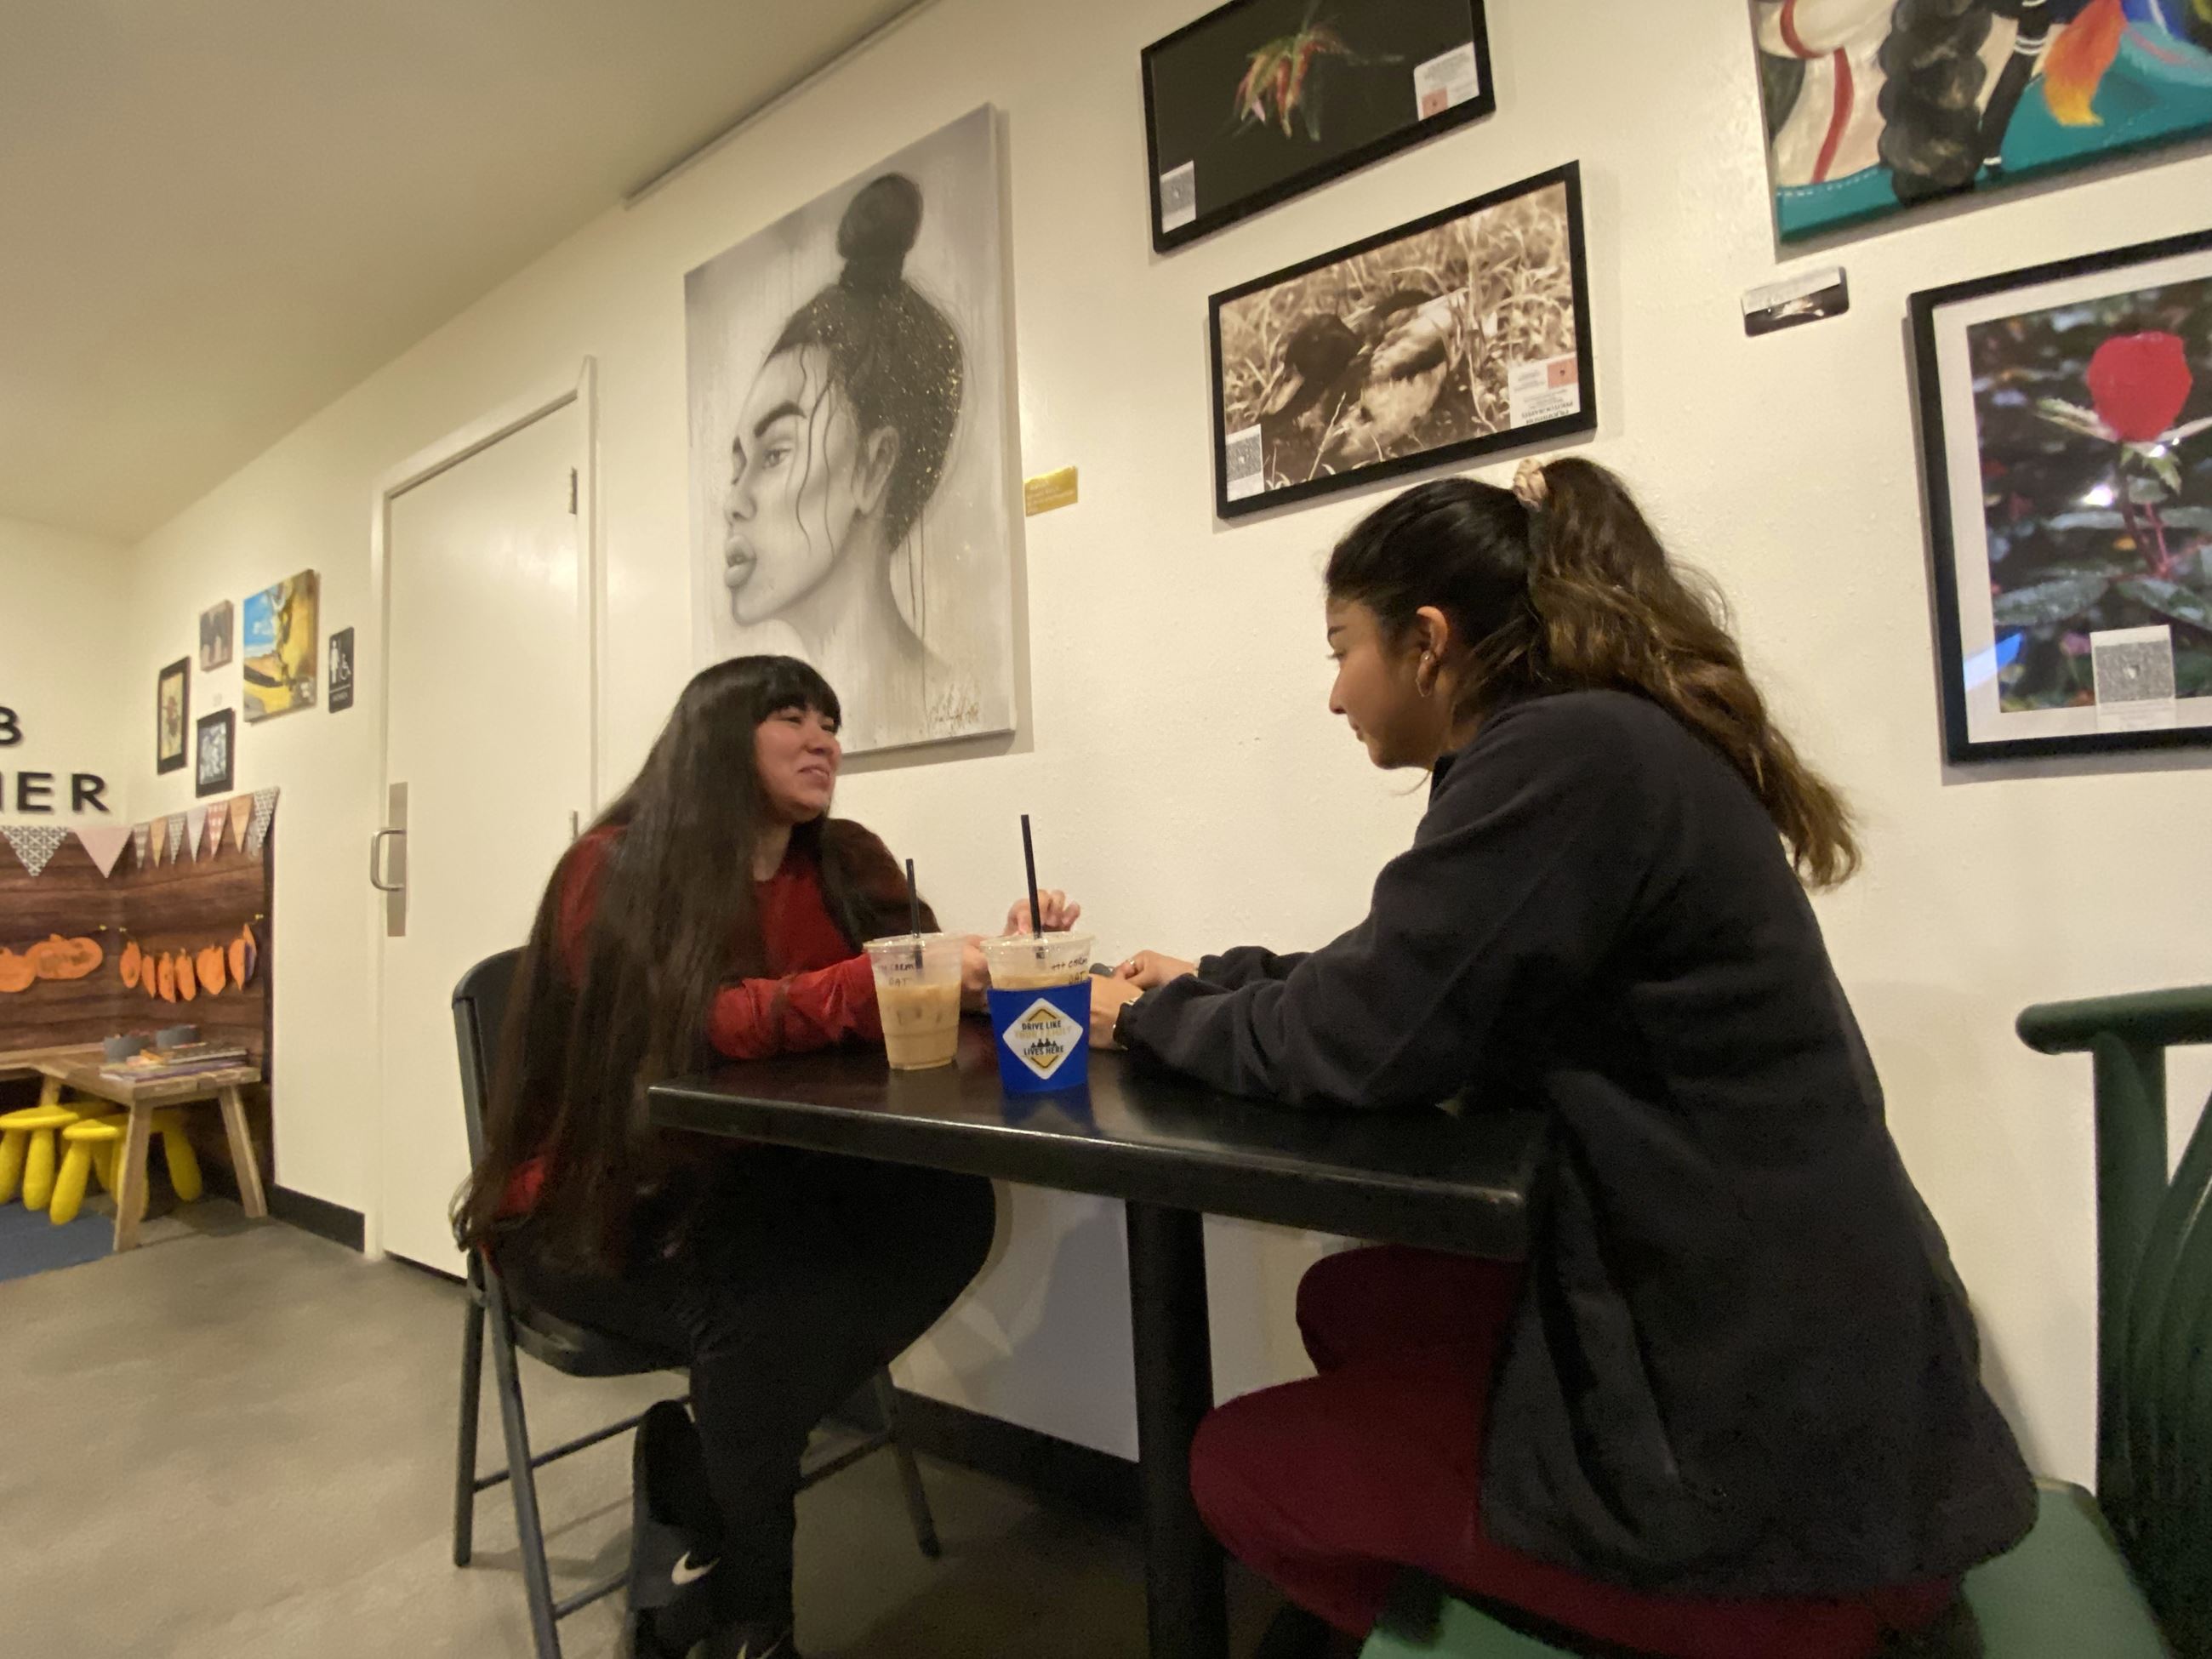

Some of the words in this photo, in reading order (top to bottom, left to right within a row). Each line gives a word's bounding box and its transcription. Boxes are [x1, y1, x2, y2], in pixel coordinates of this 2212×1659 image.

[1046, 1020, 1062, 1029] LIKE
[1023, 1047, 1044, 1056] LIVES
[1046, 1045, 1063, 1054] HERE
